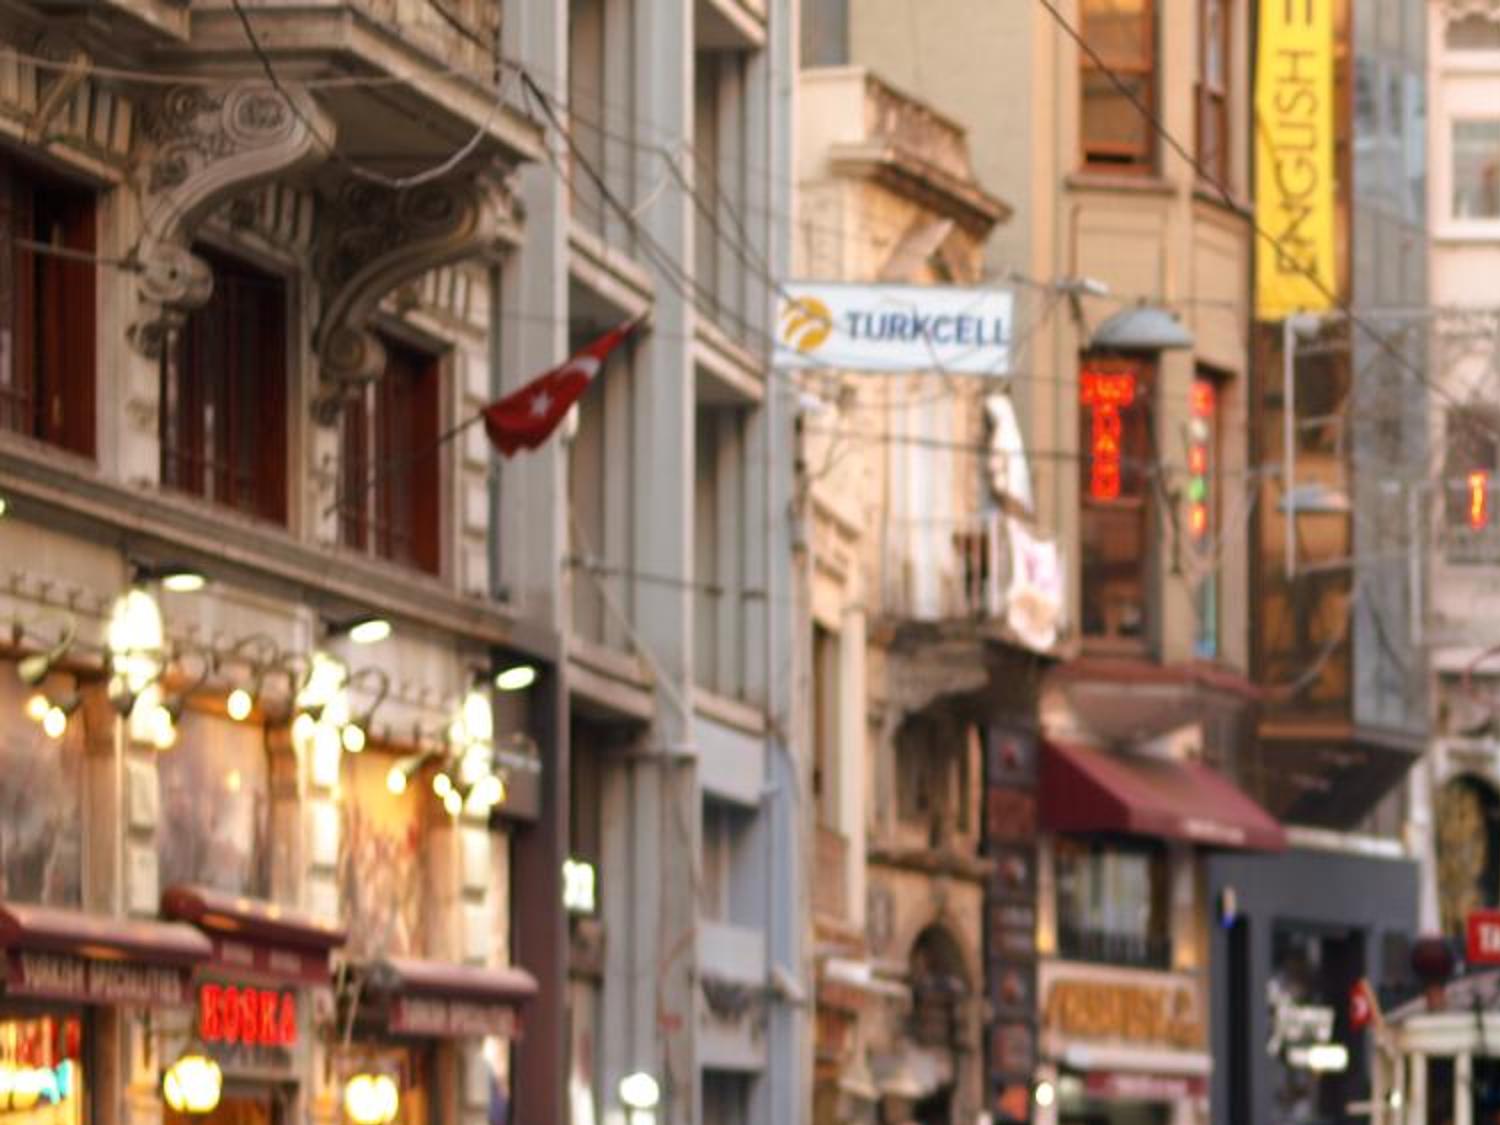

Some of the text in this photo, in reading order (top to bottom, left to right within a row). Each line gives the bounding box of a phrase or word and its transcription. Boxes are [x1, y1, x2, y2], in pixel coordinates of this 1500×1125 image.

[1273, 49, 1318, 276] ENGLISH
[846, 310, 1010, 347] TURKCELL
[202, 984, 297, 1047] KOSKA
